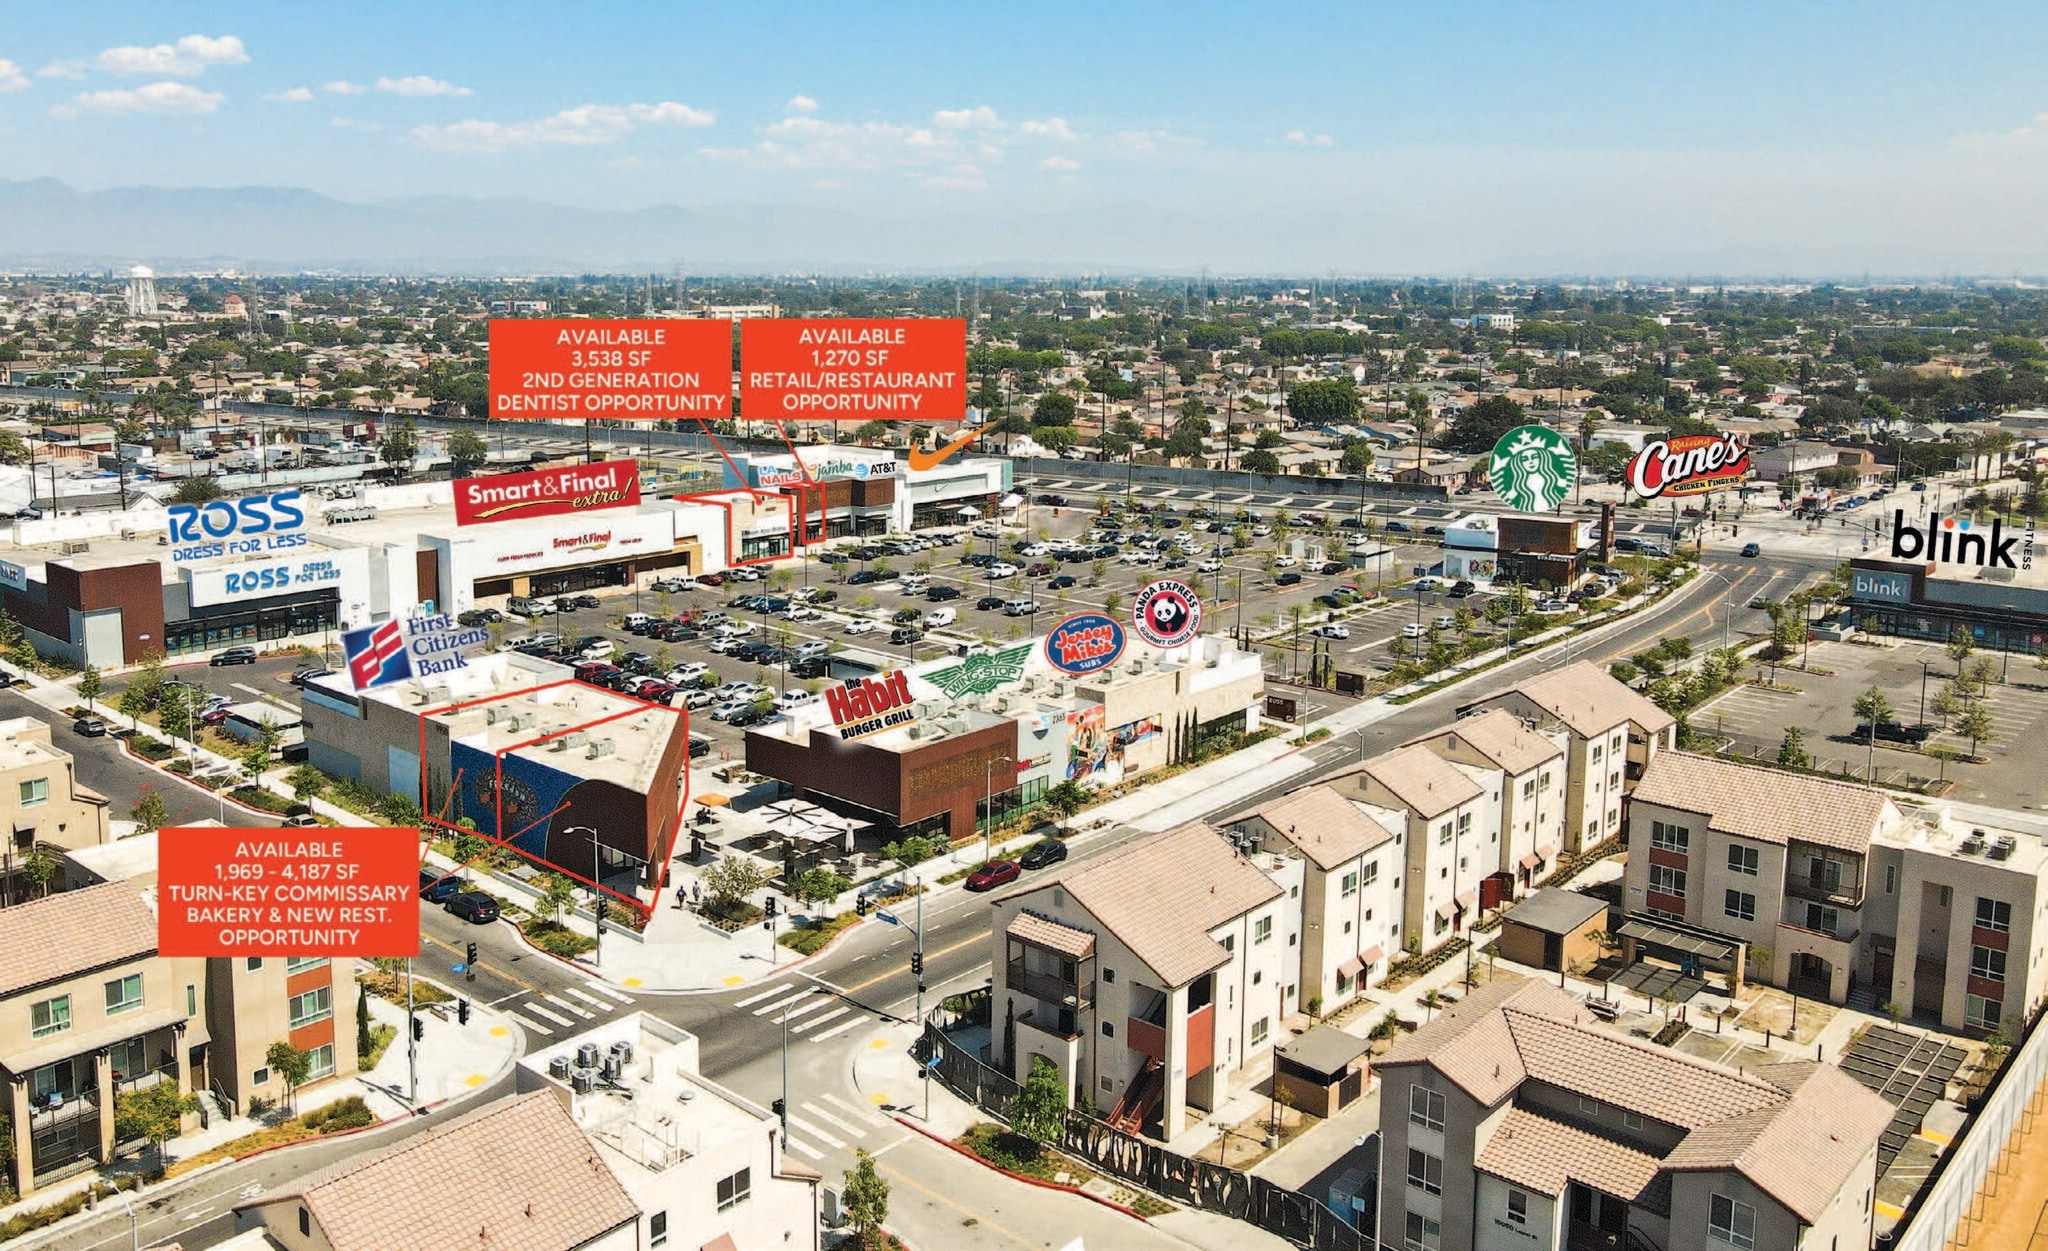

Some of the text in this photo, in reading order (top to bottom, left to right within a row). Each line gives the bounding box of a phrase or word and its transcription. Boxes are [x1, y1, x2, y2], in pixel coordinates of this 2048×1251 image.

[303, 560, 332, 572] DRESS
[225, 567, 290, 595] ROSS
[295, 568, 341, 583] FOR LESS
[1856, 576, 1902, 597] blink
